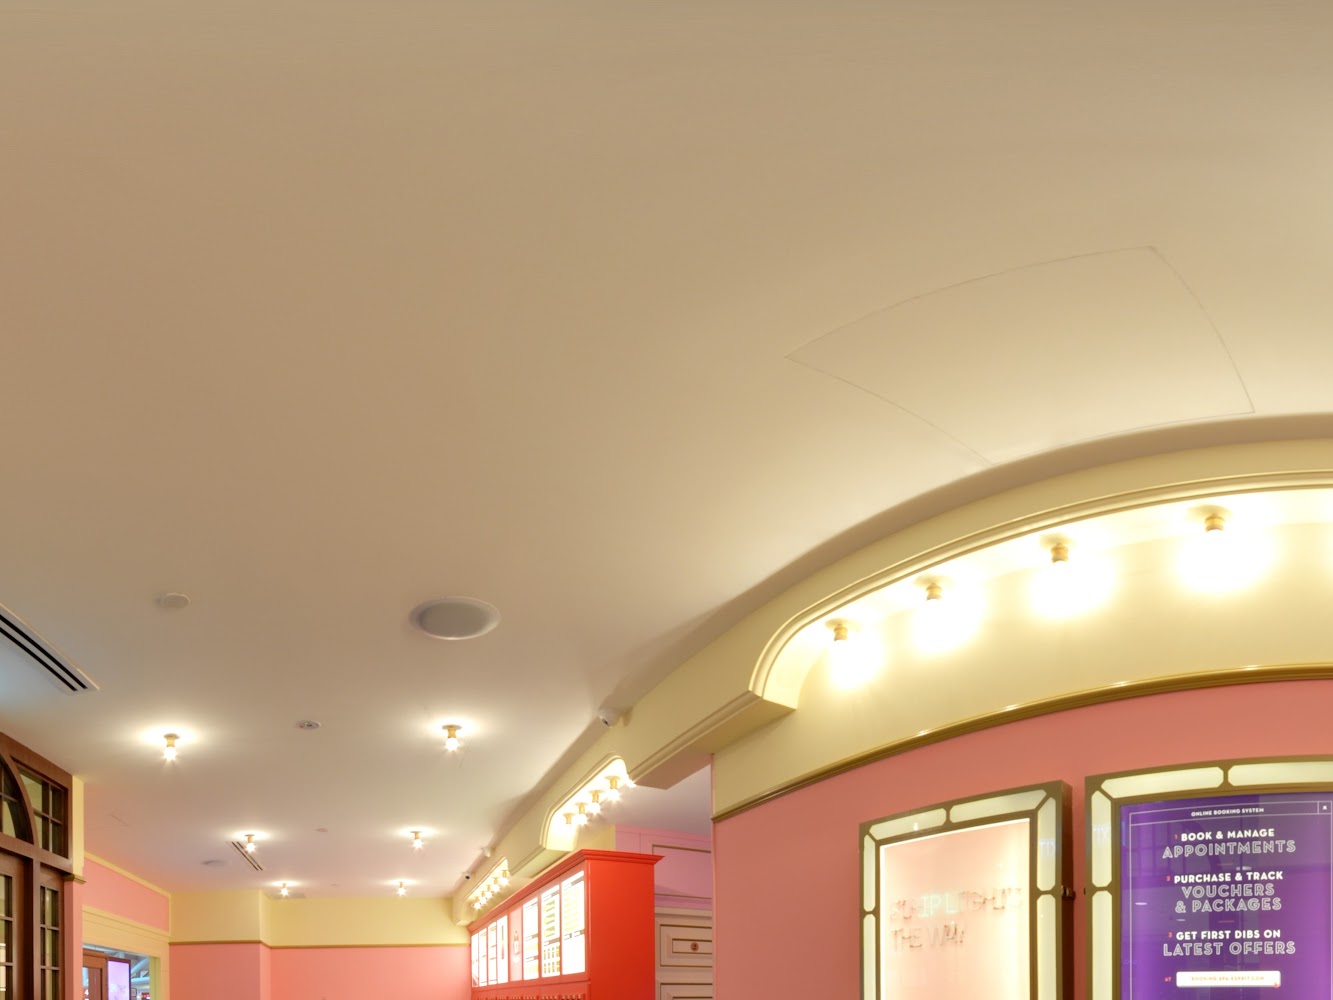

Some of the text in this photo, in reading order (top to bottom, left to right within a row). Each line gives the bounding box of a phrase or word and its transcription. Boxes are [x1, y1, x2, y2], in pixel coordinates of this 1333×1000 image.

[1181, 831, 1212, 842] BOOK
[1216, 830, 1223, 839] &
[1227, 828, 1275, 839] MANAGE
[1162, 839, 1296, 859] APPOINTMENTS
[1174, 872, 1231, 884] PURCHASE
[1235, 872, 1243, 881] &
[1246, 871, 1283, 881] TRACK
[1181, 883, 1275, 899] VOUCHERS
[1174, 897, 1282, 914] & PACKAGES
[1176, 931, 1197, 940] GET
[1201, 930, 1231, 940] FIRST
[1234, 929, 1260, 939] DIBS
[1263, 929, 1281, 938] ON
[1163, 941, 1296, 956] LATEST OFFERS
